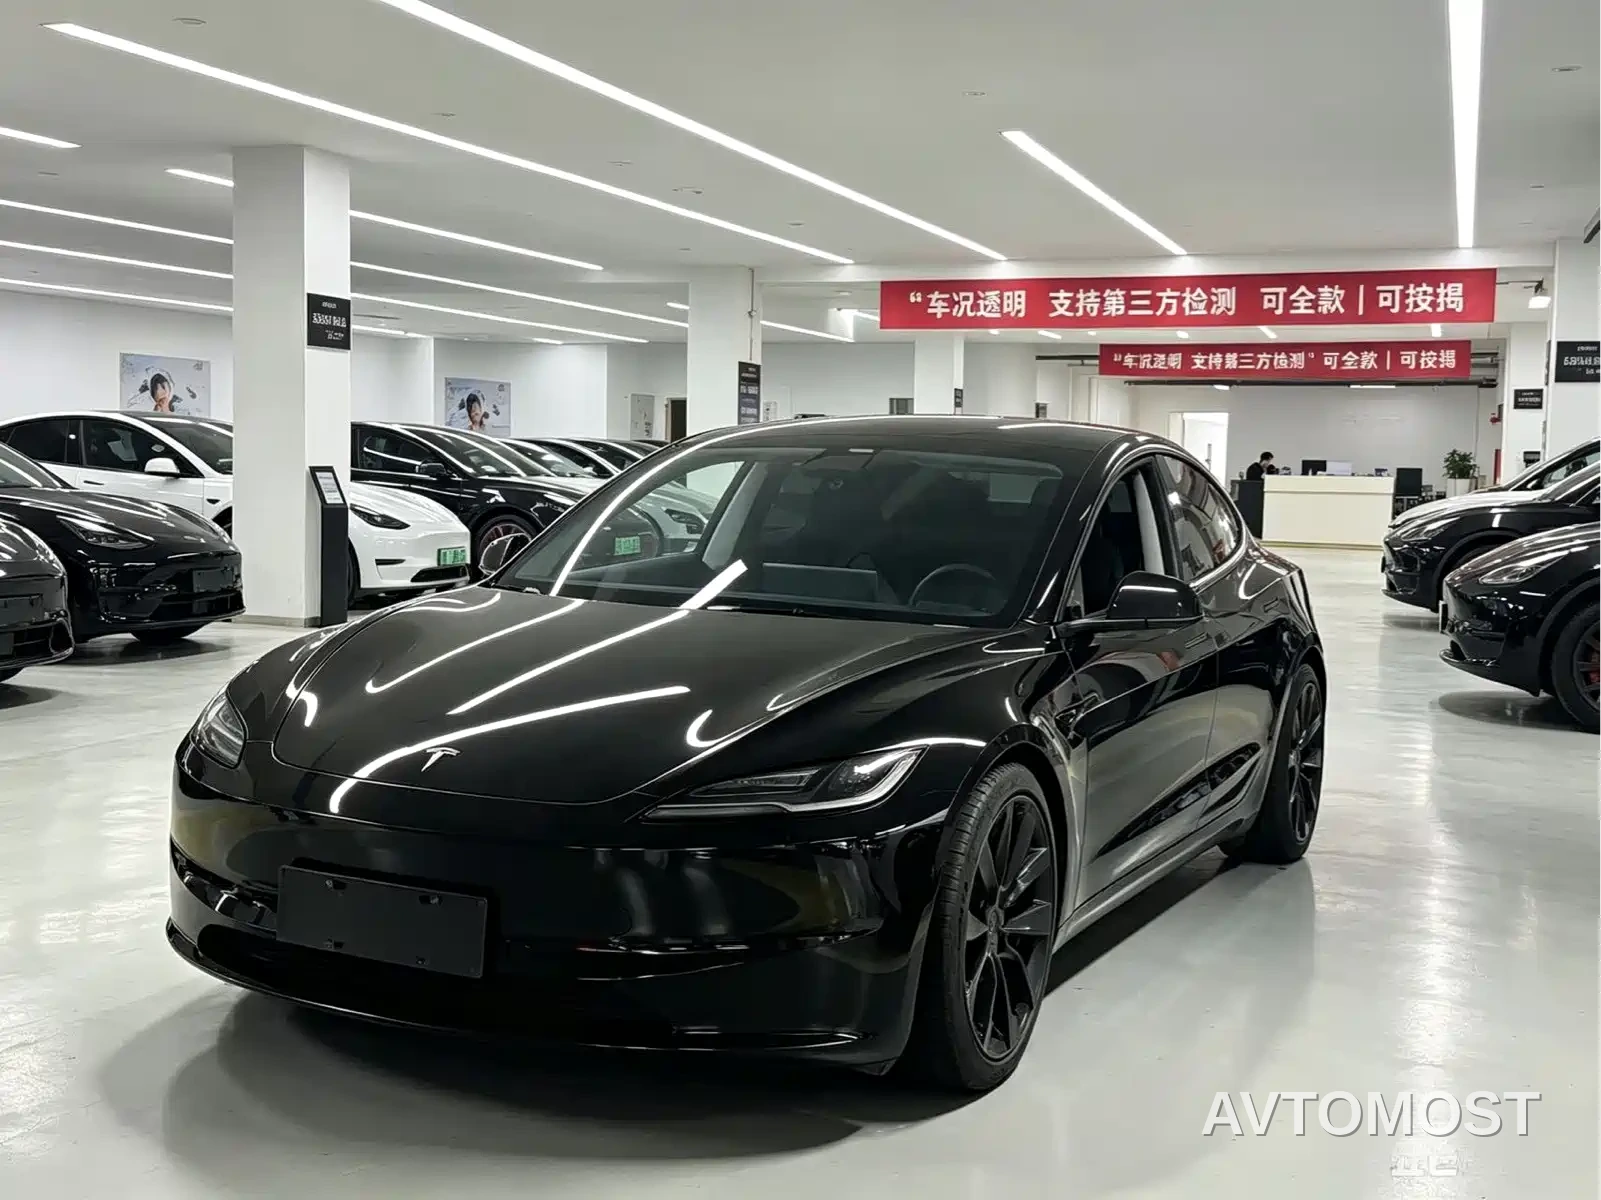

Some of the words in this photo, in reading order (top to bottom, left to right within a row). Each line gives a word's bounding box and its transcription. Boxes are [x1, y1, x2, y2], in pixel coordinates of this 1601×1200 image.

[1048, 286, 1236, 318] 支持第三方检测
